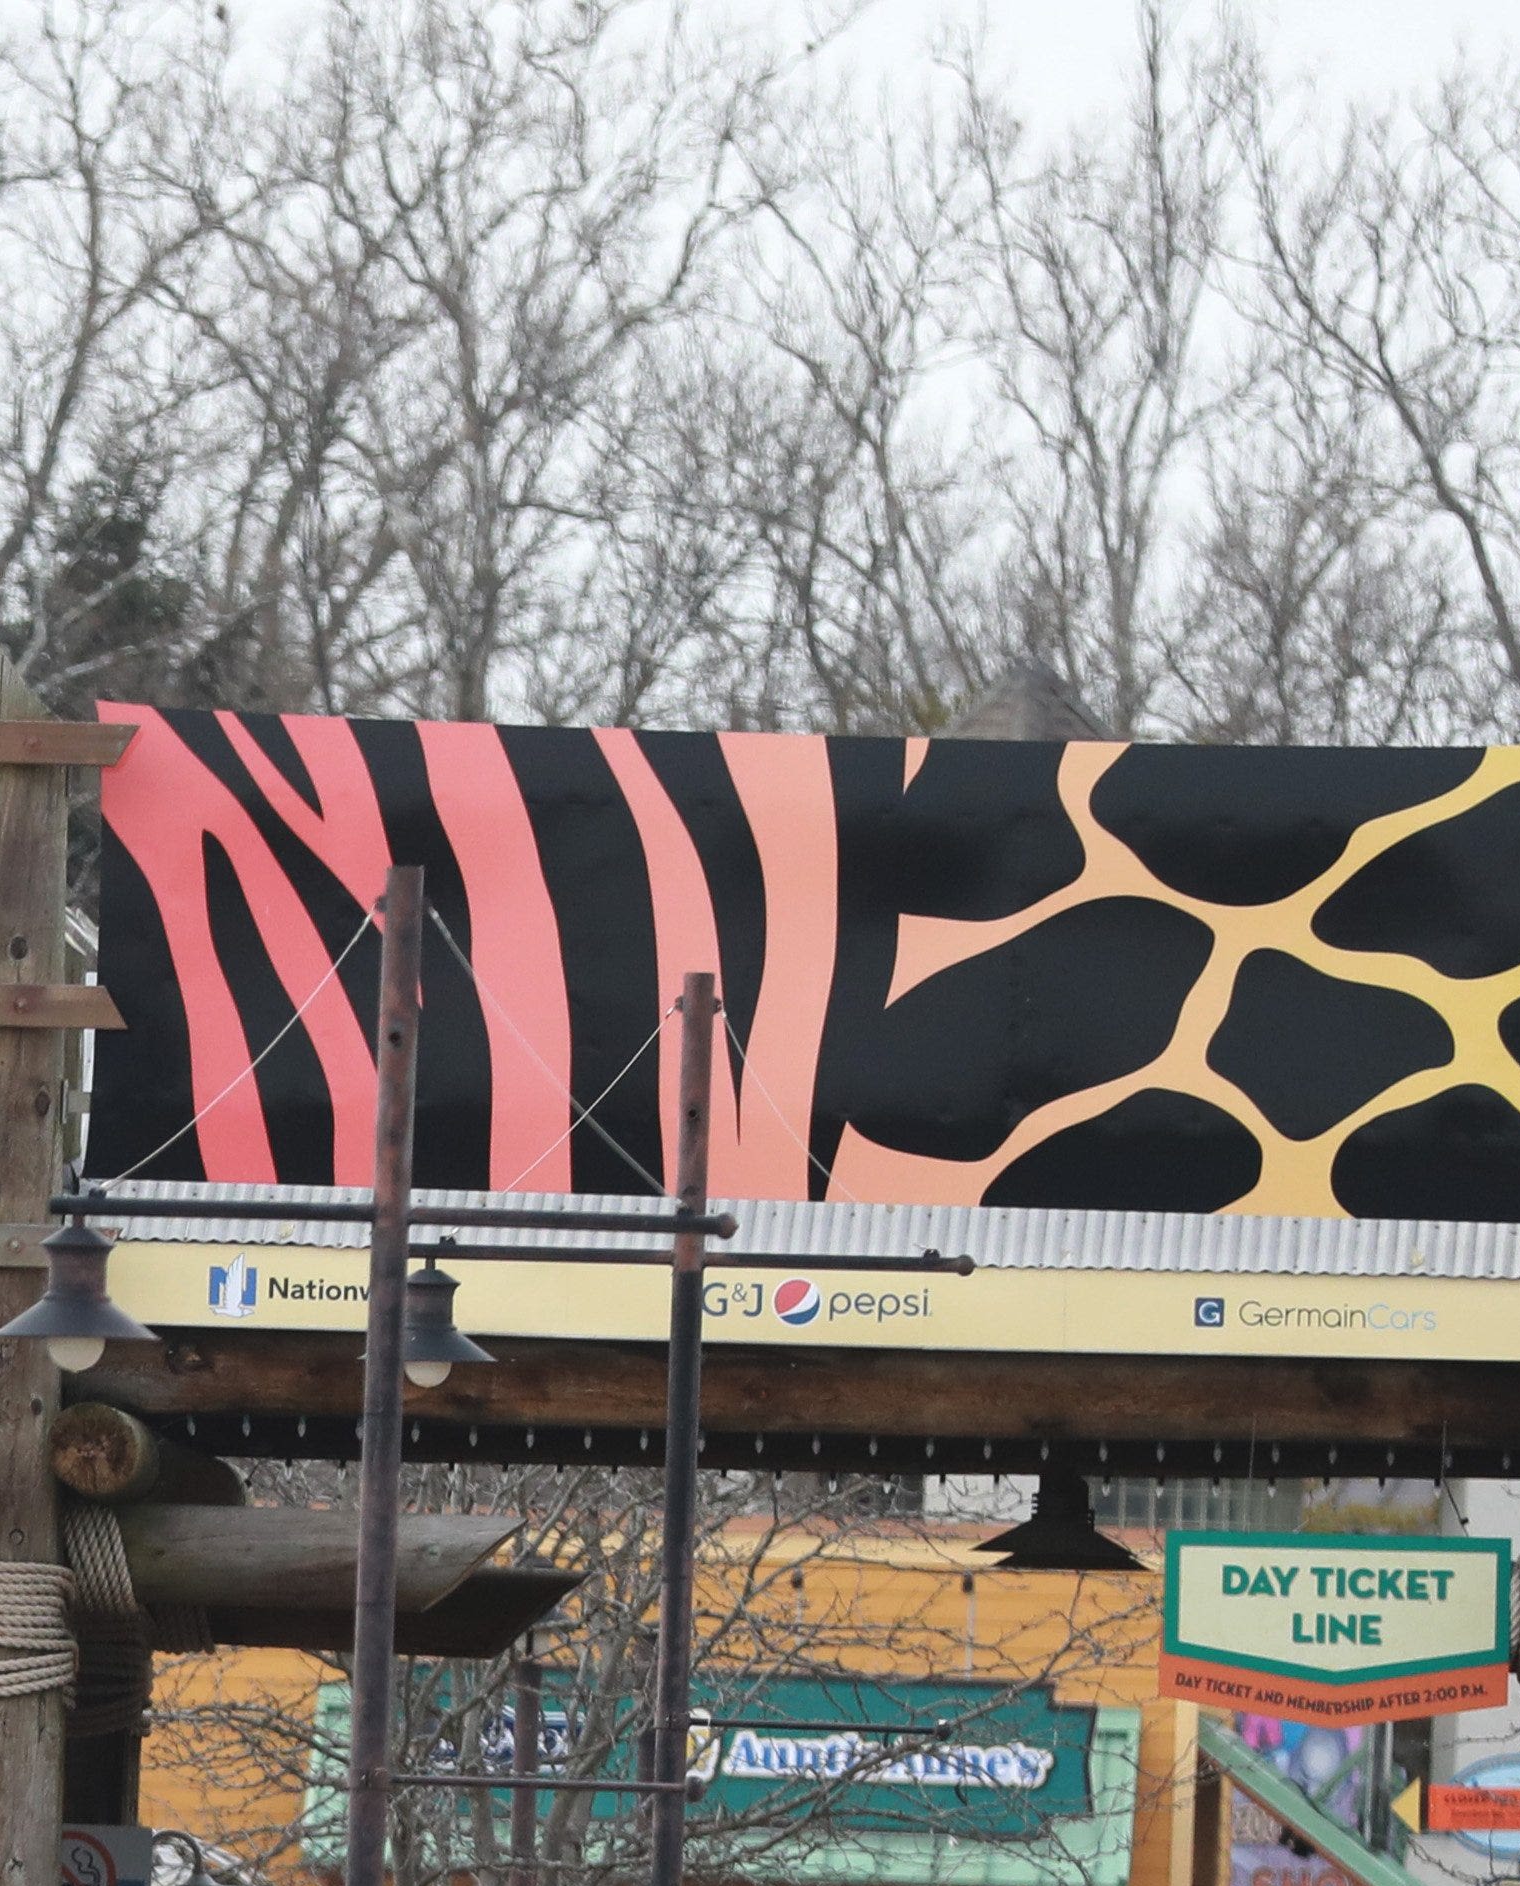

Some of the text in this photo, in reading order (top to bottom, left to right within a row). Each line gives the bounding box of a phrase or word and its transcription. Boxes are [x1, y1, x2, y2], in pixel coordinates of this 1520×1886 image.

[828, 1287, 930, 1324] pepsi
[1221, 1563, 1456, 1602] DAY TICKET
[1291, 1612, 1383, 1646] LINE
[1174, 1672, 1489, 1717] DAY TICKET AND MEMBERSHIP AFTER 2:00 P.M.
